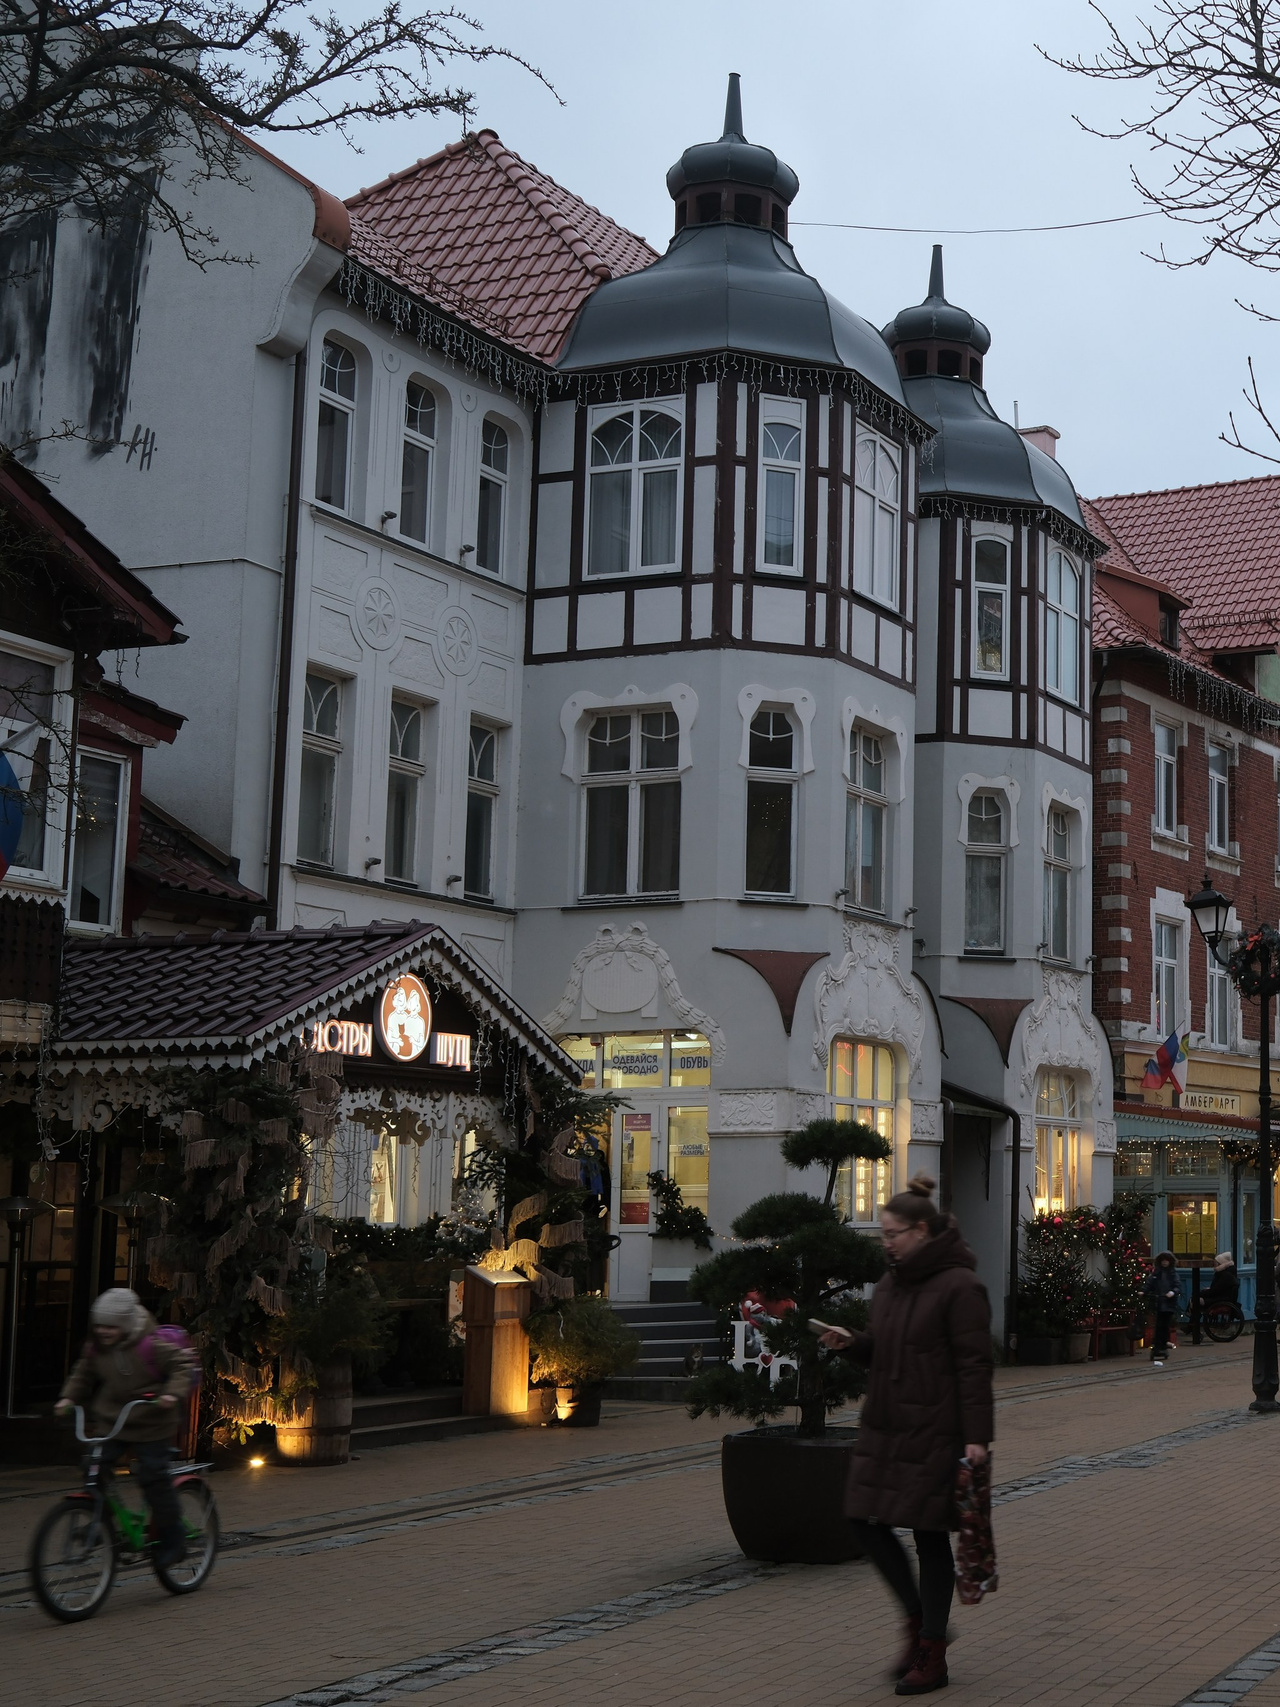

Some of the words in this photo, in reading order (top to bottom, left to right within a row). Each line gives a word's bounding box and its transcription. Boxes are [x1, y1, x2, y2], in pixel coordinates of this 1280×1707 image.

[436, 1032, 471, 1072] ШУТЦ
[612, 1053, 658, 1065] ОДЕВАЙСЯ
[680, 1056, 709, 1069] ОБУВЬ
